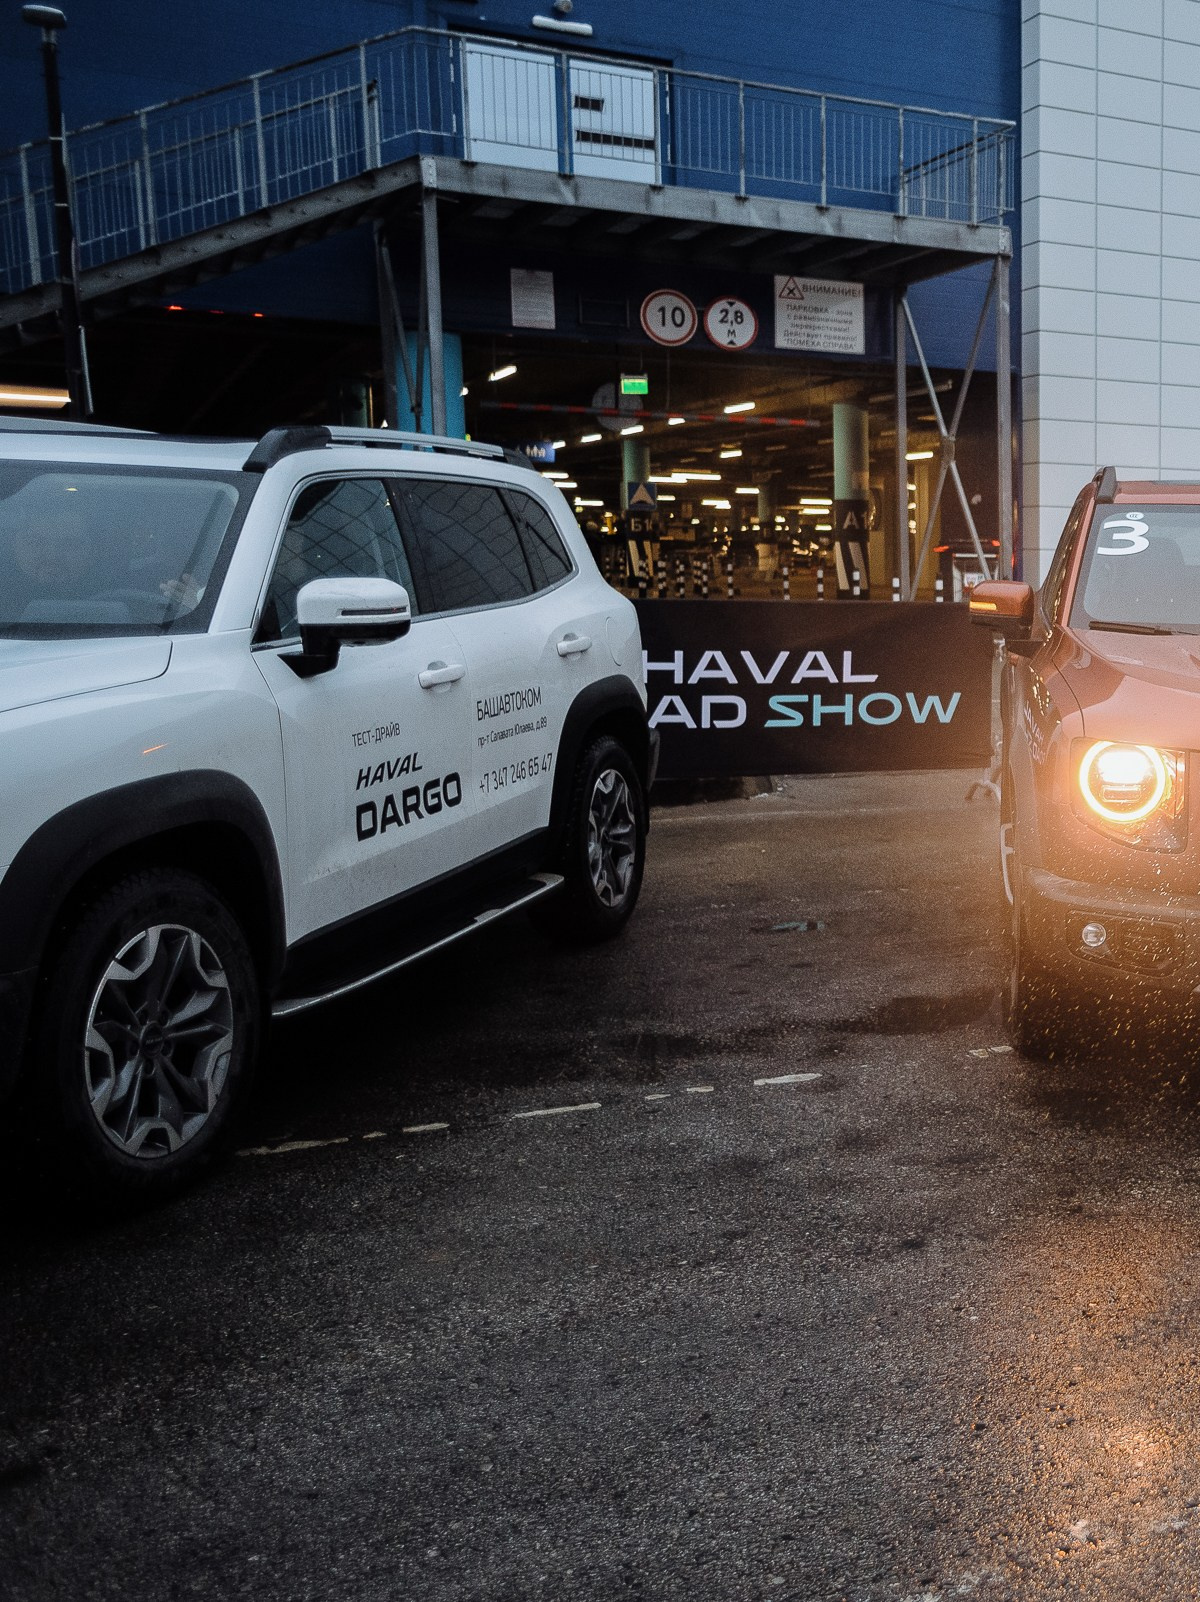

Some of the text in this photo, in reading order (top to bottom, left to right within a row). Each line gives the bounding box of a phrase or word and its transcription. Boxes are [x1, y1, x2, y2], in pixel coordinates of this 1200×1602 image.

[802, 285, 861, 297] ВНИМАНИЕ!
[658, 306, 686, 328] 10
[719, 308, 744, 326] 2,8
[1097, 520, 1150, 556] 3
[642, 650, 878, 684] HAVAL
[476, 686, 542, 722] БАШАВТОКОМ
[648, 692, 962, 729] AD SHOW
[352, 721, 401, 748] ТЕСТ-ДРАЙВ
[490, 730, 514, 743] Салавата
[356, 752, 423, 791] HAVAL
[480, 752, 553, 793] +7 347 246 65 47
[356, 772, 462, 842] DARGO
